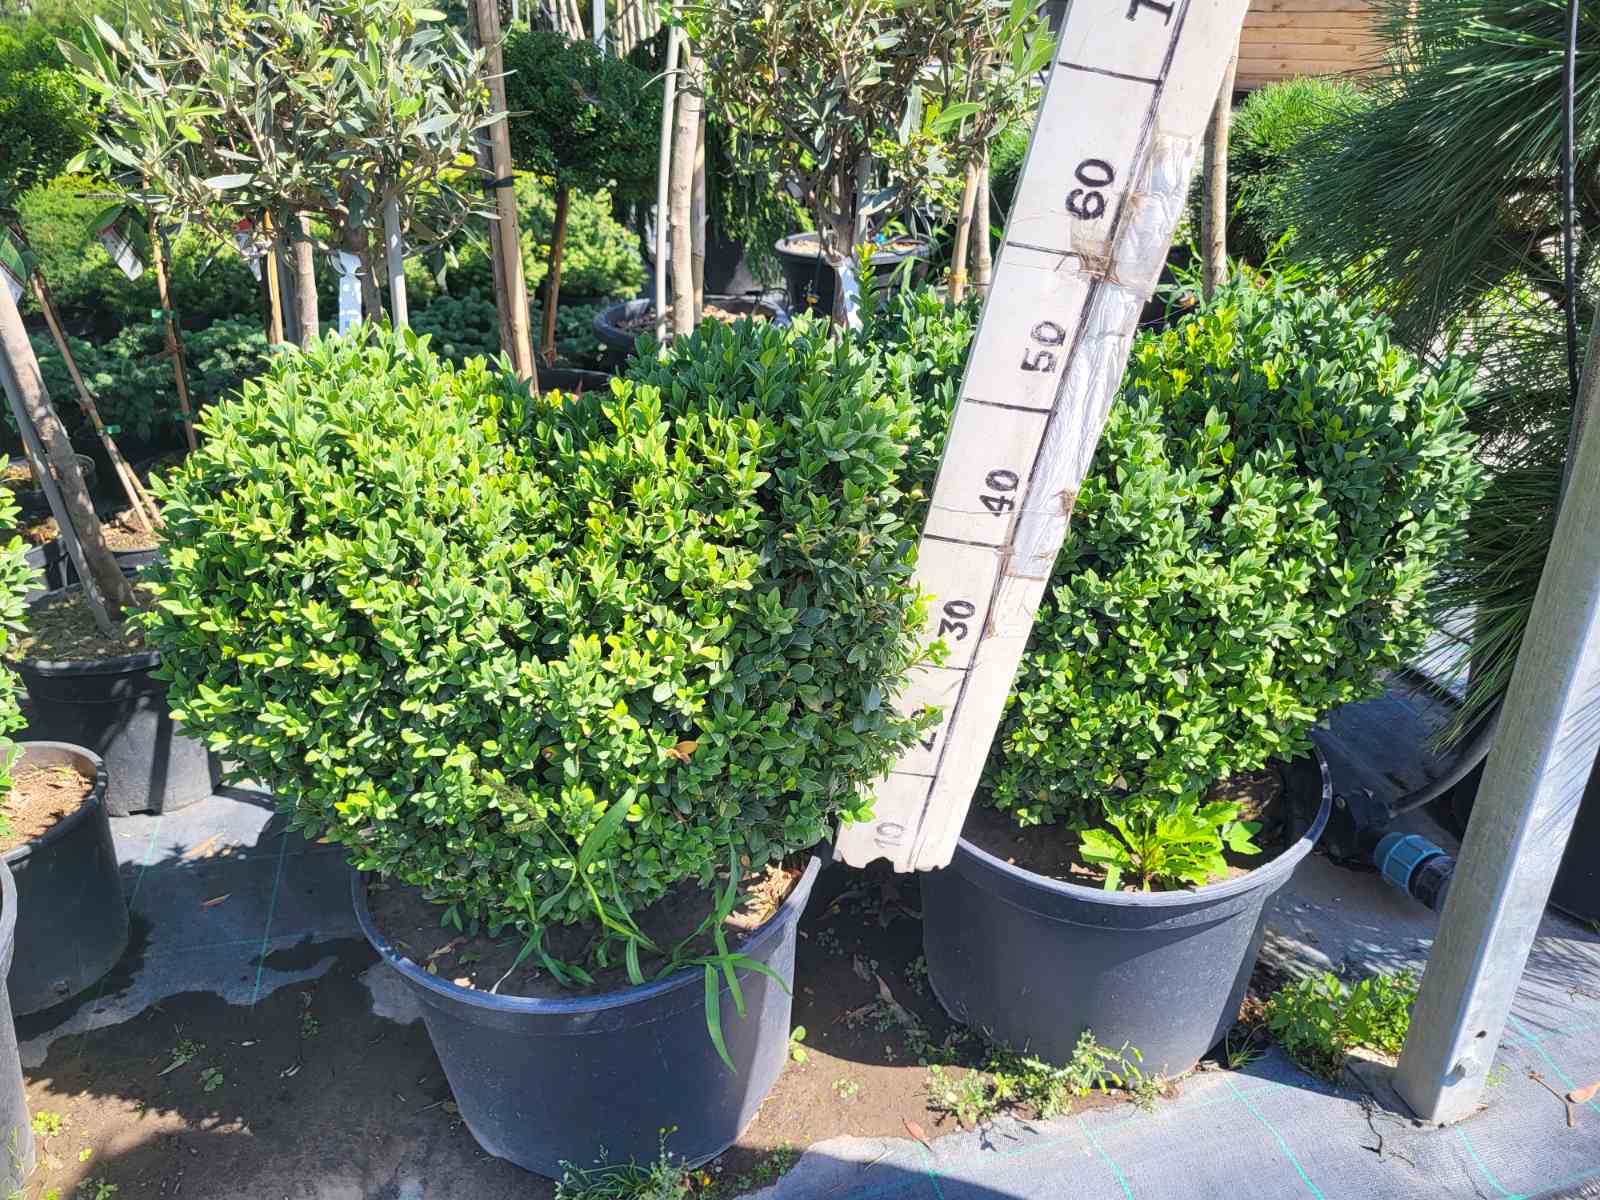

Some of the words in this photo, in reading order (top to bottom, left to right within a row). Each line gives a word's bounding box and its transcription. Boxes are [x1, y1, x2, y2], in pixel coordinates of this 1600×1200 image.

[1065, 158, 1115, 220] 60
[1020, 320, 1066, 373] 50
[979, 469, 1019, 517] 40
[937, 600, 976, 641] 30
[873, 821, 904, 848] 10
